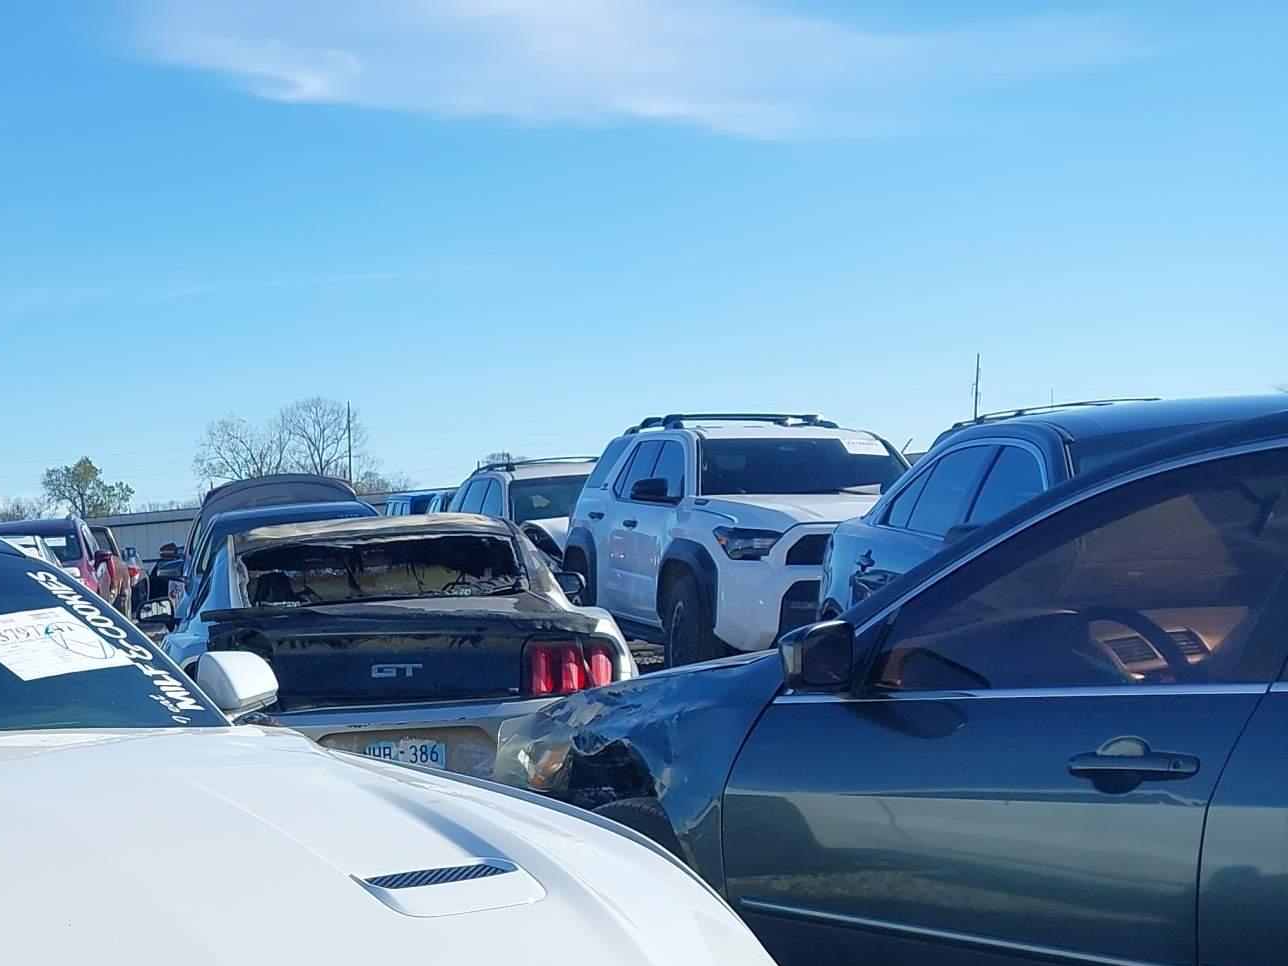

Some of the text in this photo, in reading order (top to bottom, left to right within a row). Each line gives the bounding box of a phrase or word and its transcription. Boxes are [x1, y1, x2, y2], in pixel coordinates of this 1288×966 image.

[26, 571, 128, 640] COOKIES
[134, 662, 206, 711] MILF
[371, 663, 424, 679] GT
[409, 743, 439, 764] 386
